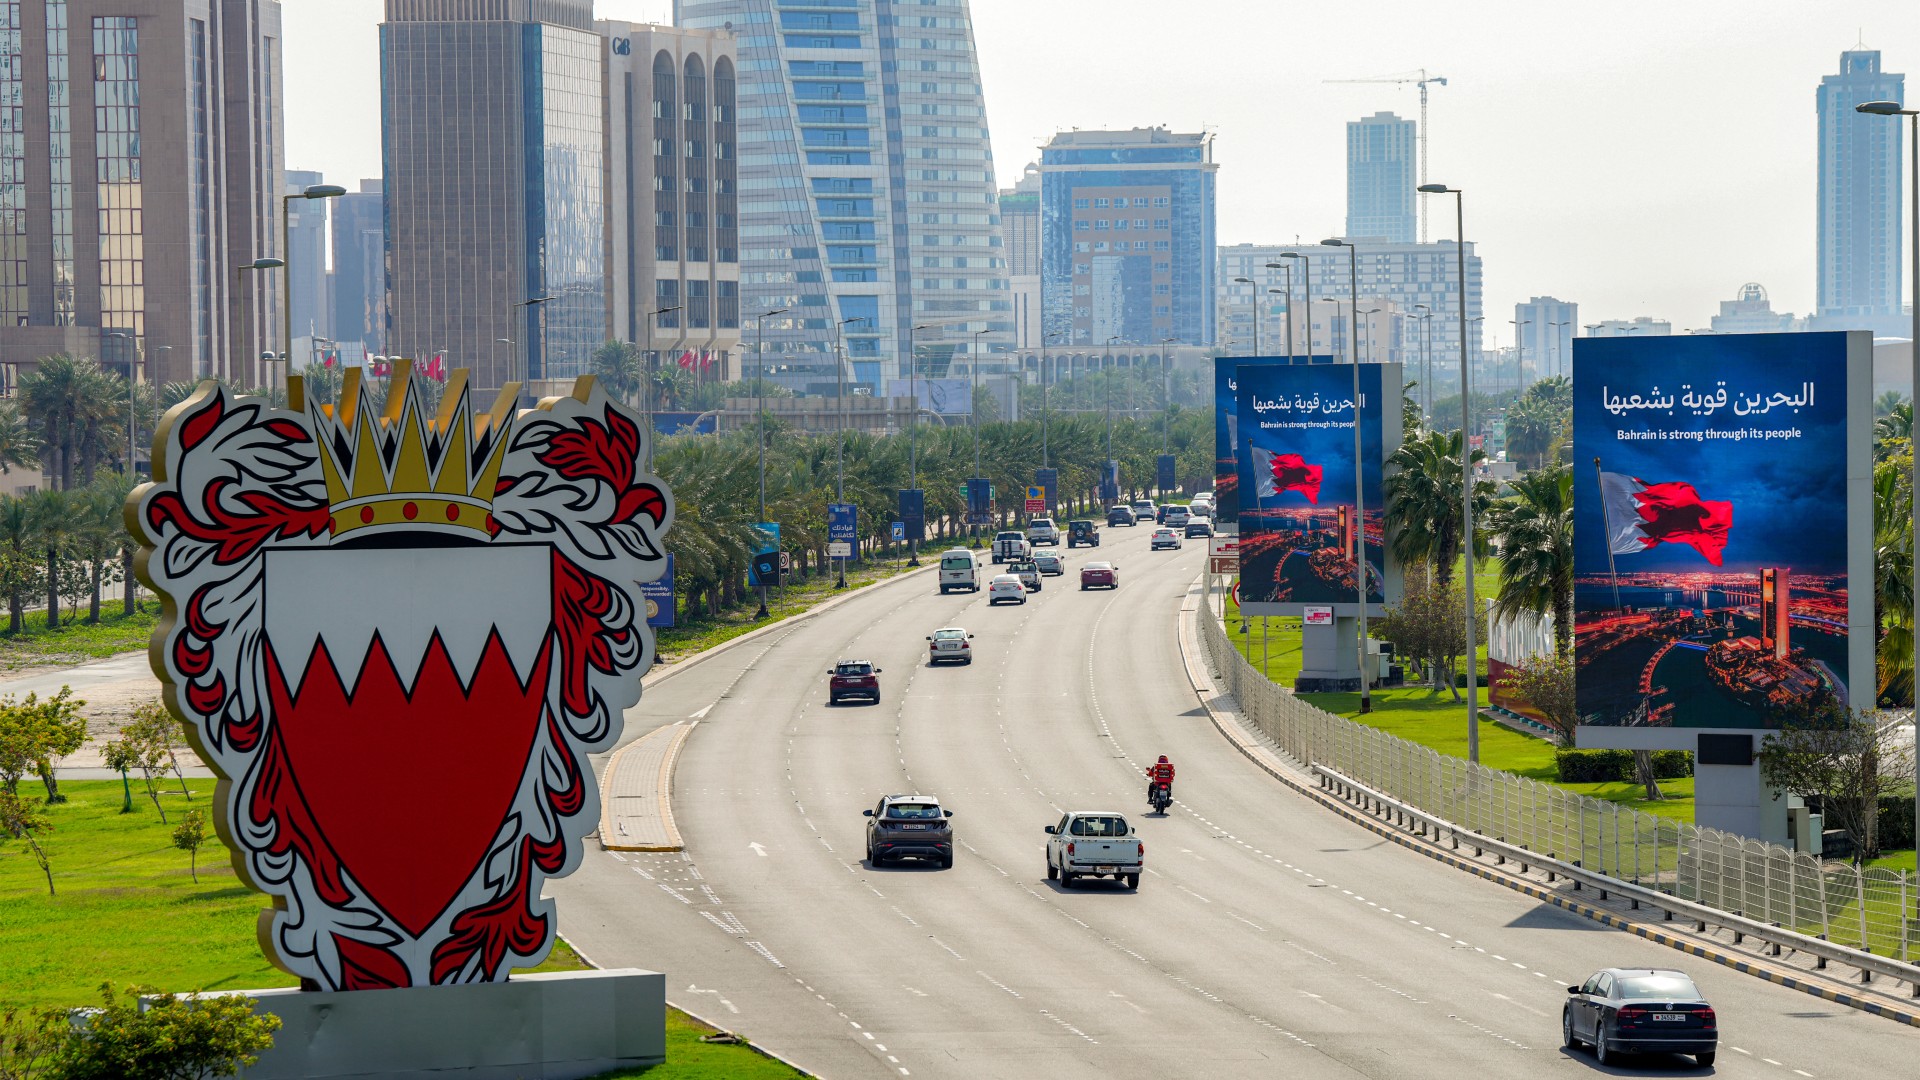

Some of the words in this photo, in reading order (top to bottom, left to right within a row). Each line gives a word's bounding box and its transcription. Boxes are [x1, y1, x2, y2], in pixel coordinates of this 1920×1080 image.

[1253, 395, 1291, 414] بشعبها
[1295, 393, 1319, 413] قوية
[1603, 386, 1675, 417] بشعبها
[1681, 381, 1728, 416] قوية
[1734, 382, 1815, 416] البحرين
[1307, 421, 1330, 429] through
[1617, 429, 1657, 440] Bahrain
[1658, 428, 1667, 439] is
[1669, 429, 1703, 442] strong
[1705, 428, 1748, 442] through
[1749, 427, 1763, 439] its
[1765, 427, 1801, 441] people
